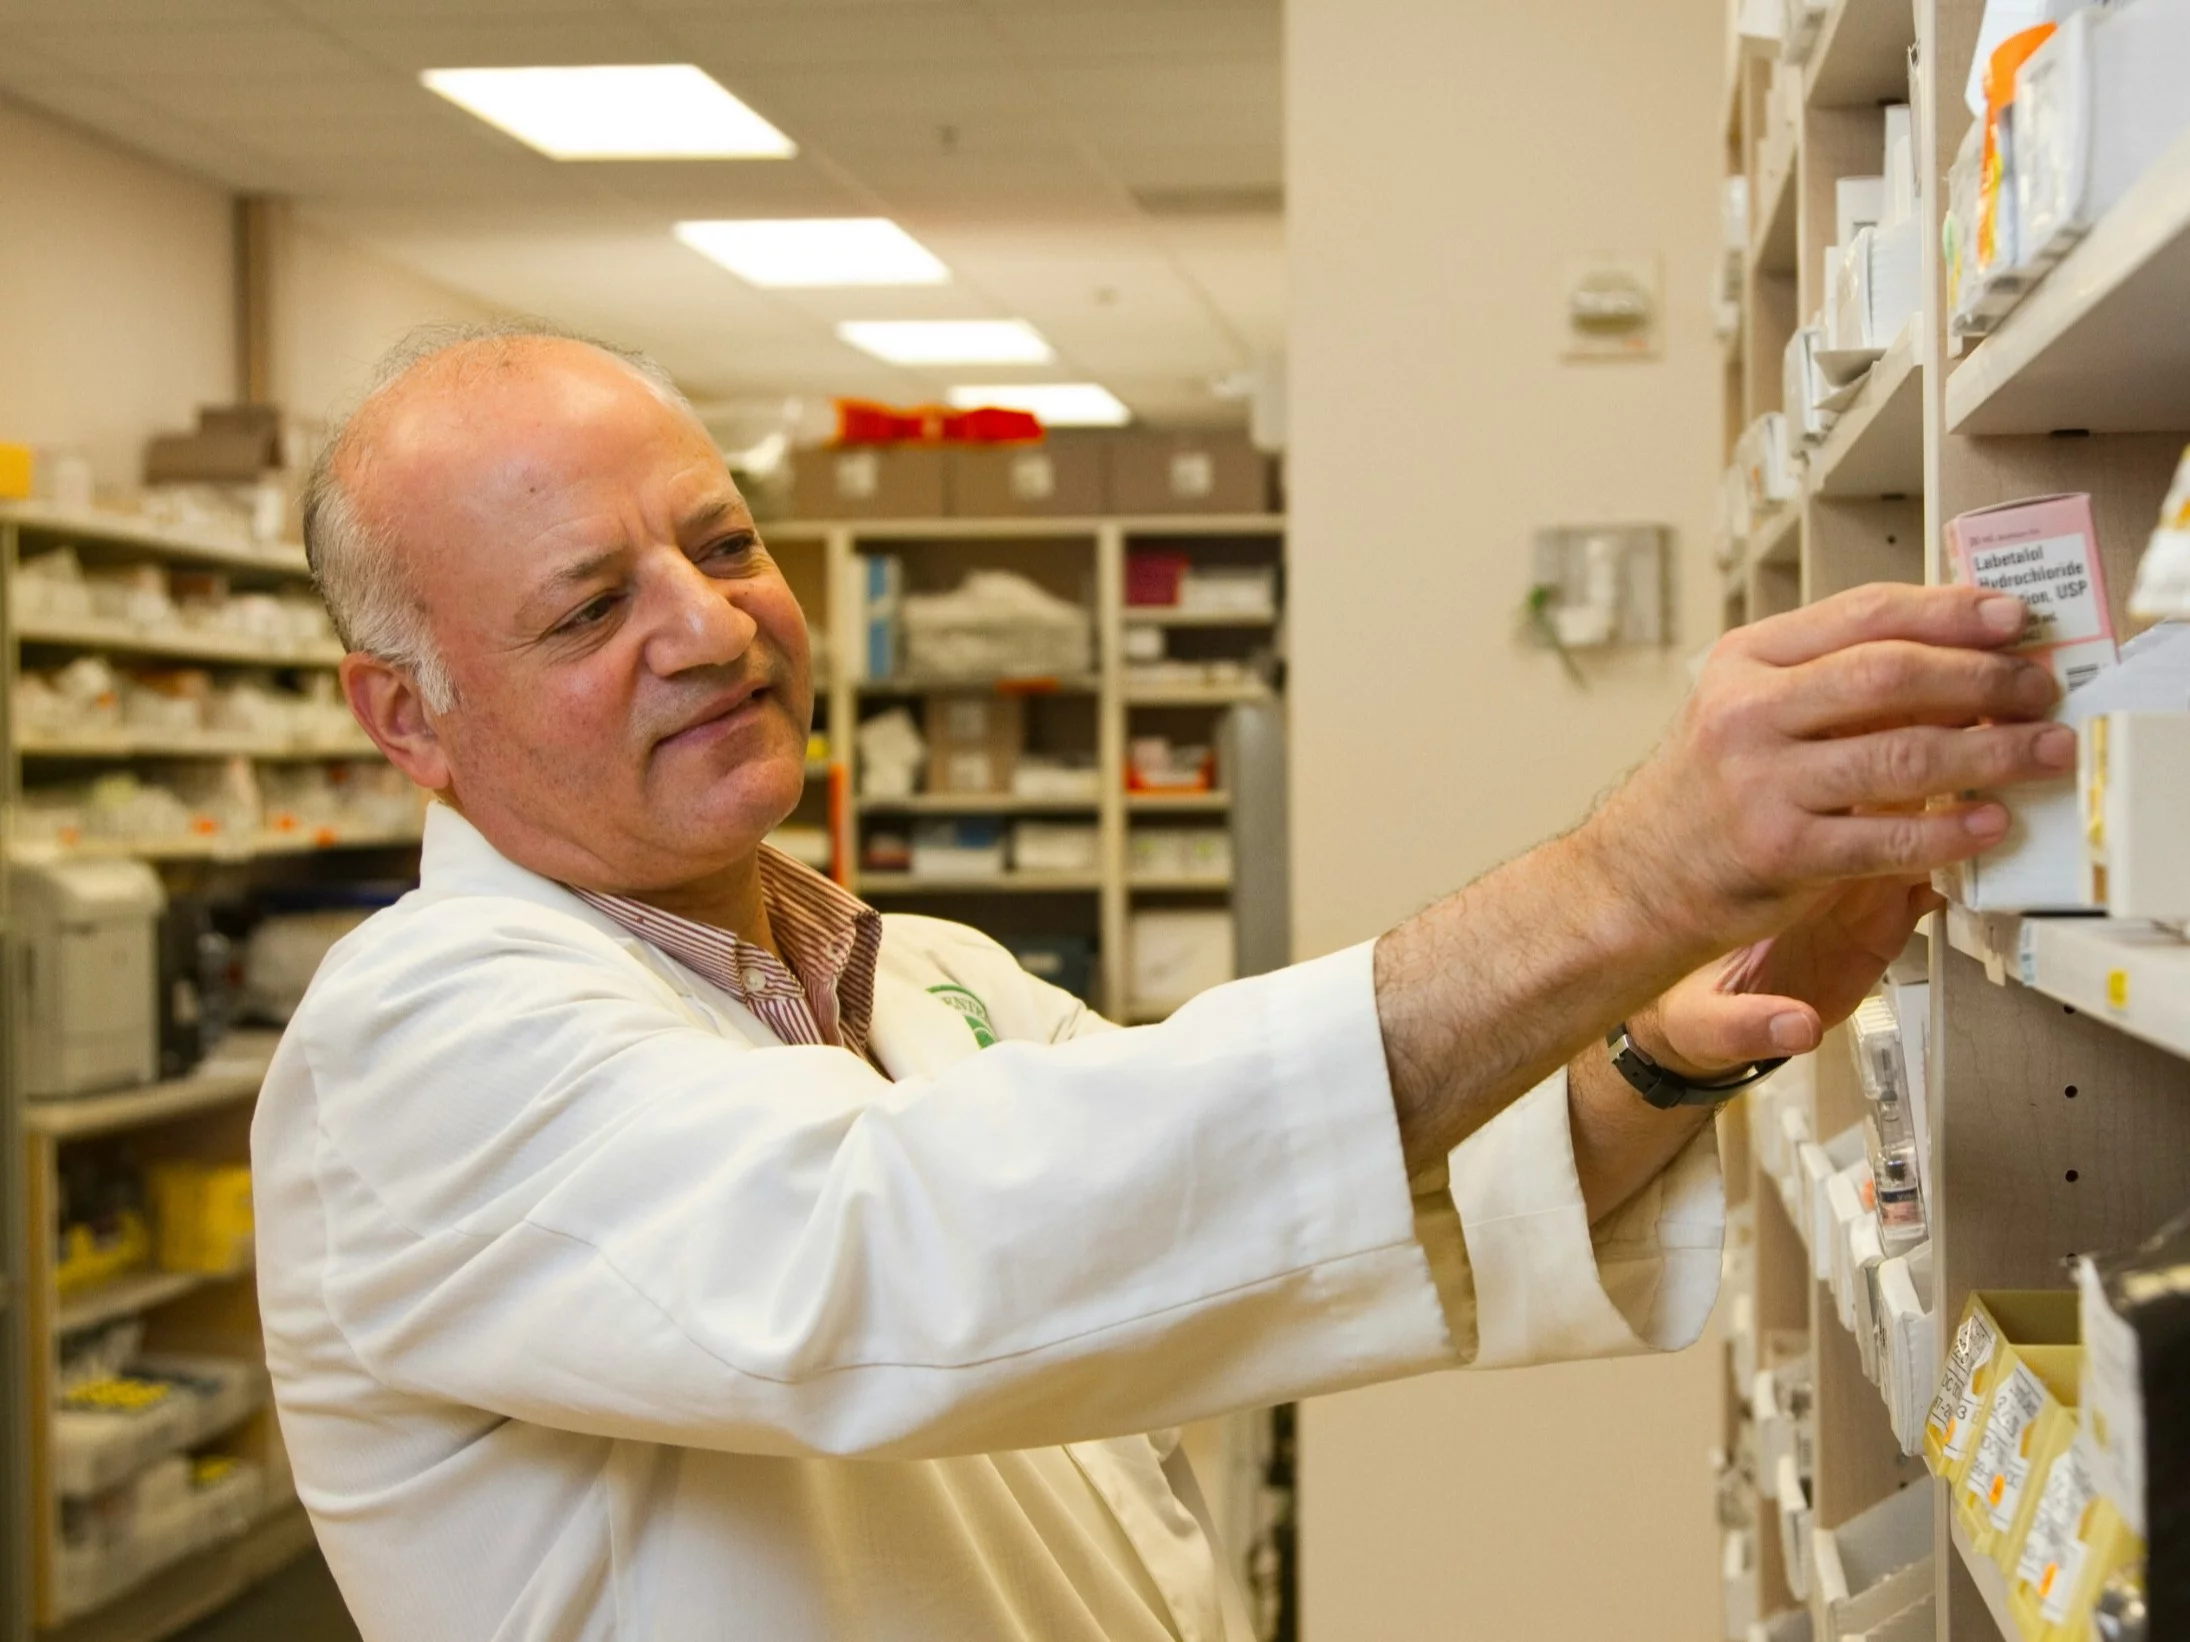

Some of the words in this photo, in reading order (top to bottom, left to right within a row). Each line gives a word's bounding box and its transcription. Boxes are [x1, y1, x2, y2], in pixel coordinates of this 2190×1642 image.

[1974, 545, 2044, 571] Labetalol
[1978, 561, 2084, 589] Hydrochloride
[2055, 579, 2088, 600] USP
